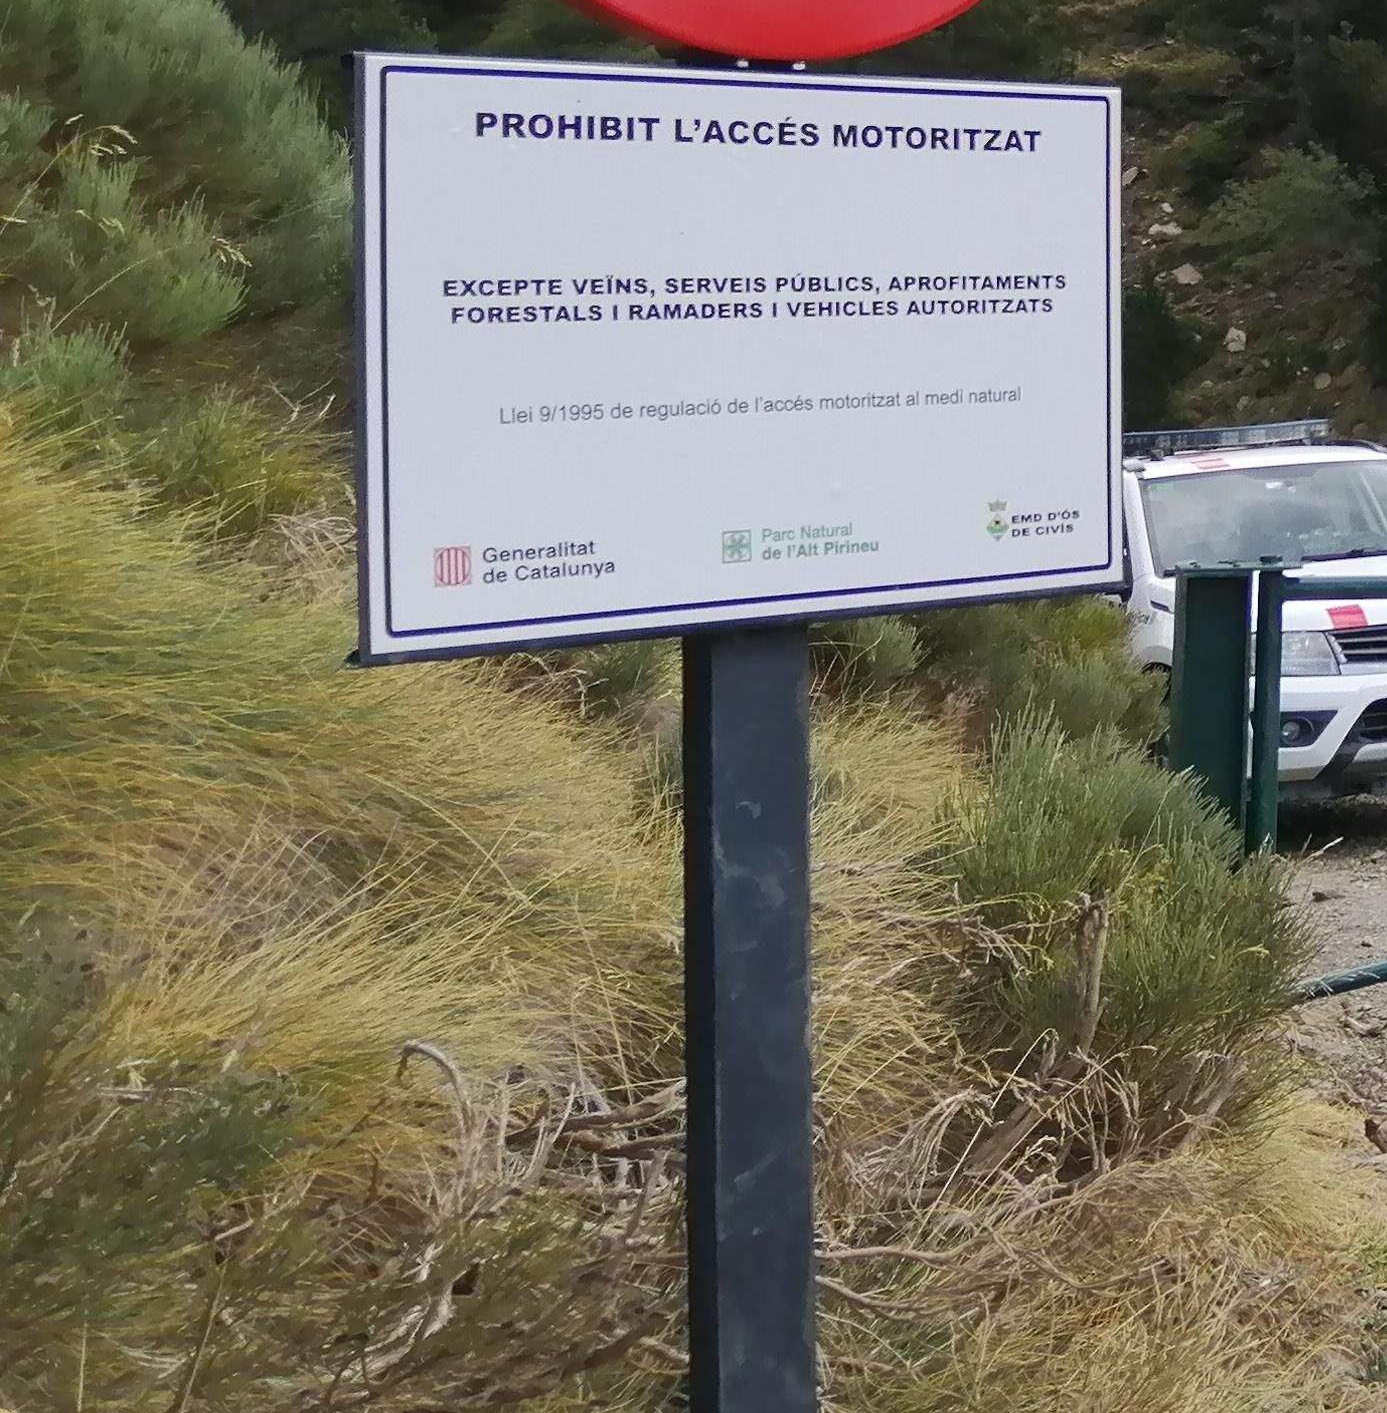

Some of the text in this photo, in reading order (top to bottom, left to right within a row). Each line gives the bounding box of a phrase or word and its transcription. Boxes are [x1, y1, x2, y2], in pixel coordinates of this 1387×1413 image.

[475, 112, 1042, 152] PROHIBIT L'ACCÉS MOTORITZAT
[444, 273, 1065, 298] EXCEPTE VEÏNS, SERVEIS PÚBLICS, APROFITAMENTS
[452, 305, 602, 324] FORESTALS
[613, 305, 618, 320] I
[629, 303, 762, 320] RAMADERS
[787, 301, 898, 317] VEHICLES
[907, 299, 1052, 315] AUTORITZATS
[500, 387, 1020, 424] Llei 9/1995 de regulació de l'accés motoritzat al medi natural
[1011, 513, 1043, 524] EMD
[762, 522, 853, 543] Parc Natural
[1012, 528, 1030, 538] DE
[482, 541, 596, 563] Generalitat
[762, 540, 880, 561] de l'Alt Pirineu
[482, 560, 616, 584] de Catalunya
